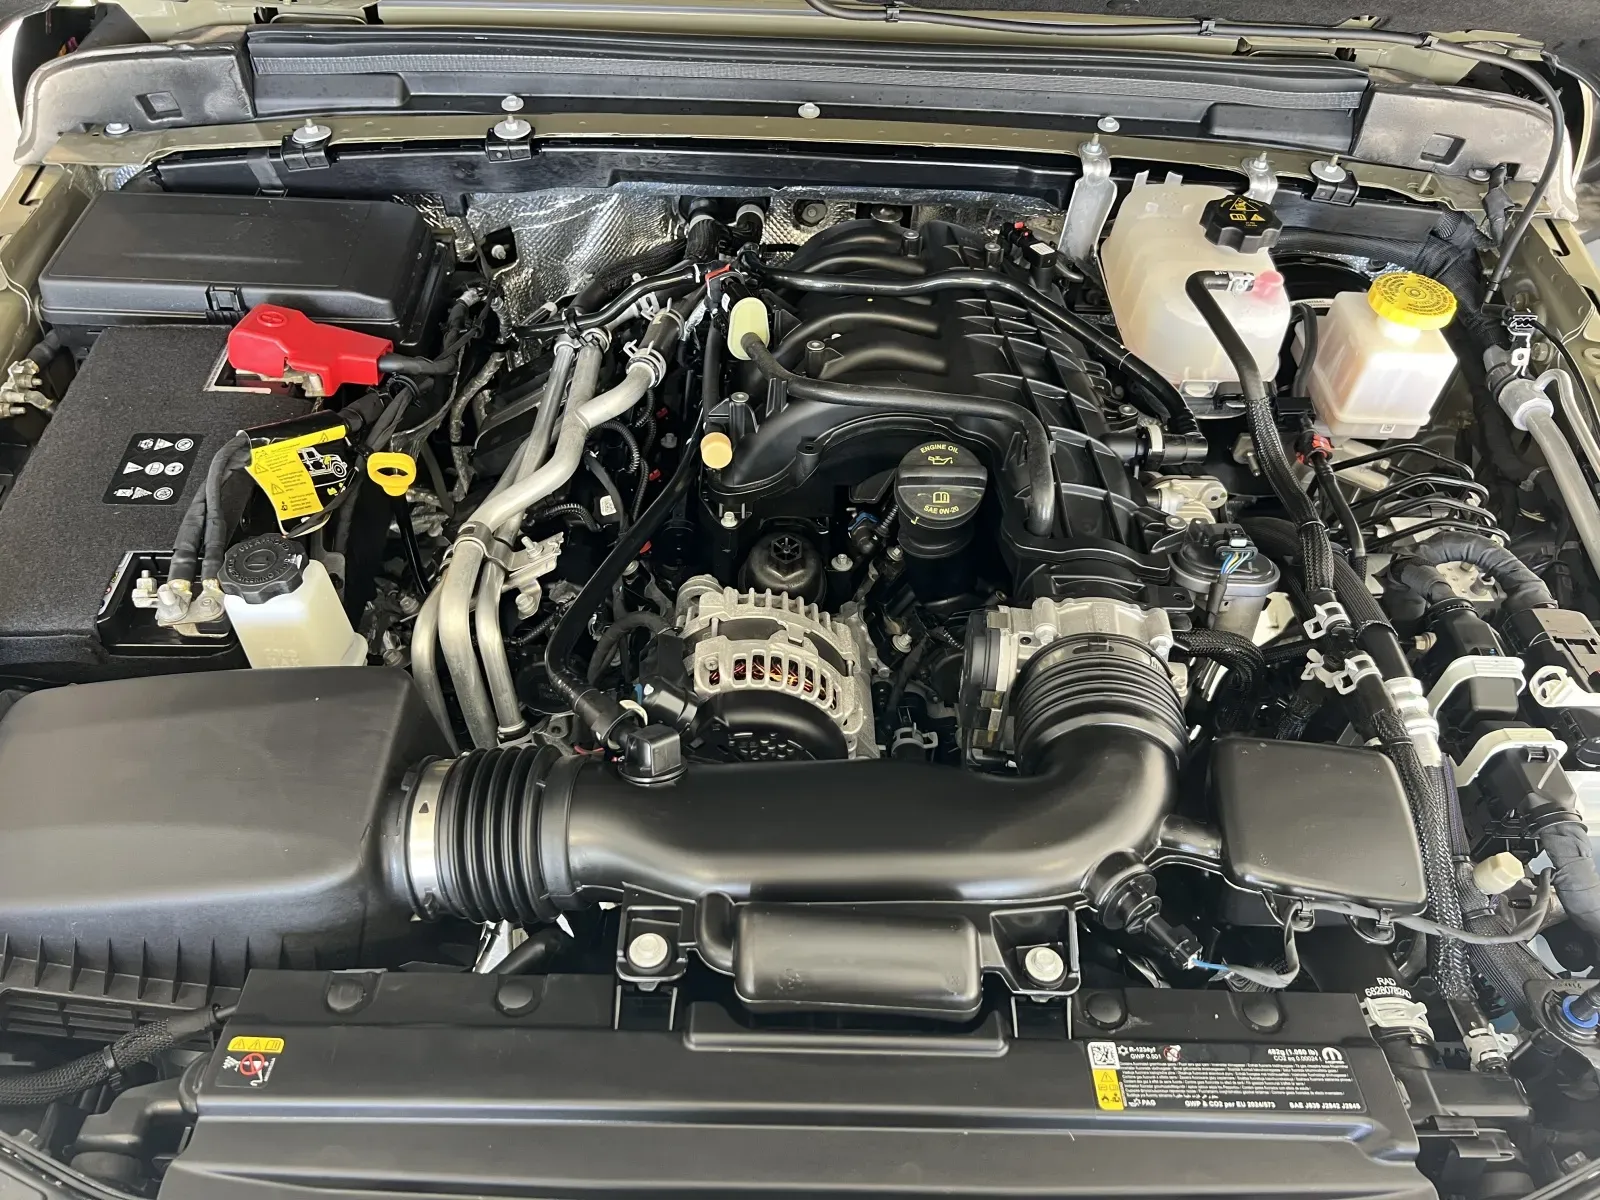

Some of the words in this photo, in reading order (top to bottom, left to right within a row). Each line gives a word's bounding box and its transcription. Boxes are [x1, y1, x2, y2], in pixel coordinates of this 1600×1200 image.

[920, 444, 946, 454] ENGINE
[947, 445, 959, 454] OIL
[923, 504, 938, 514] SAE
[939, 505, 959, 514] 0W-20
[239, 572, 274, 583] STEERING
[1376, 977, 1397, 986] RAD
[1129, 1046, 1156, 1054] R-1234yf
[1208, 1100, 1223, 1108] CO2
[1224, 1101, 1235, 1109] per
[1235, 1100, 1246, 1108] EU
[1289, 1101, 1304, 1109] SAE
